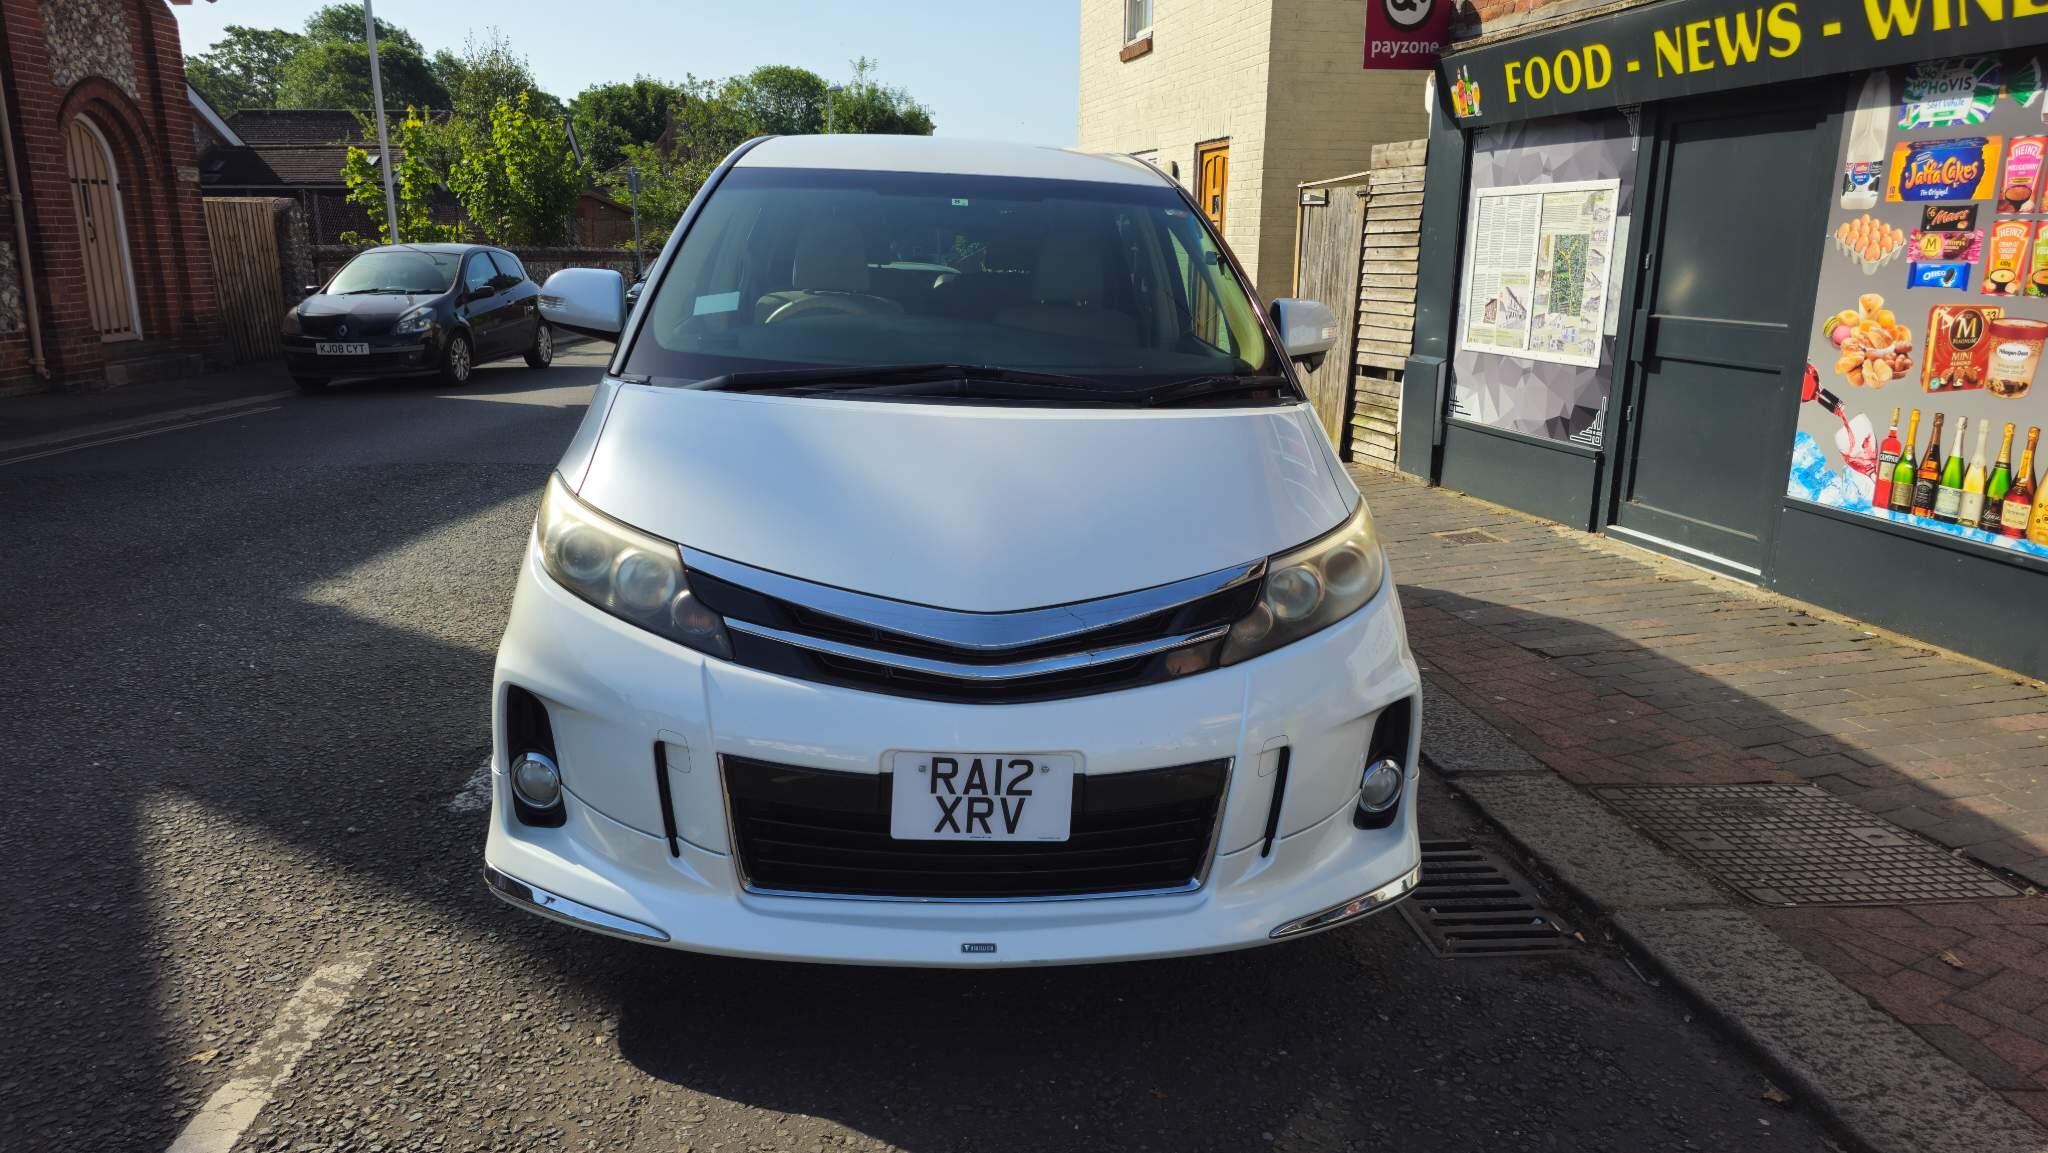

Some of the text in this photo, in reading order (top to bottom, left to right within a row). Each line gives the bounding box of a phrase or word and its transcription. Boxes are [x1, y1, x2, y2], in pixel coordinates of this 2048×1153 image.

[1371, 40, 1440, 59] payzone
[1504, 44, 1612, 104] FOOD
[1653, 2, 1801, 78] NEWS
[2015, 144, 2037, 157] HEINZ
[1905, 156, 1979, 189] Jaffa Cakes
[1931, 209, 1969, 225] Mars
[2000, 227, 2024, 238] HEINZ
[1923, 270, 1946, 281] OREO
[320, 344, 365, 353] KJ08 CYT
[1951, 351, 1972, 361] MINI
[930, 757, 1034, 796] RA12
[934, 796, 1026, 834] XRV
